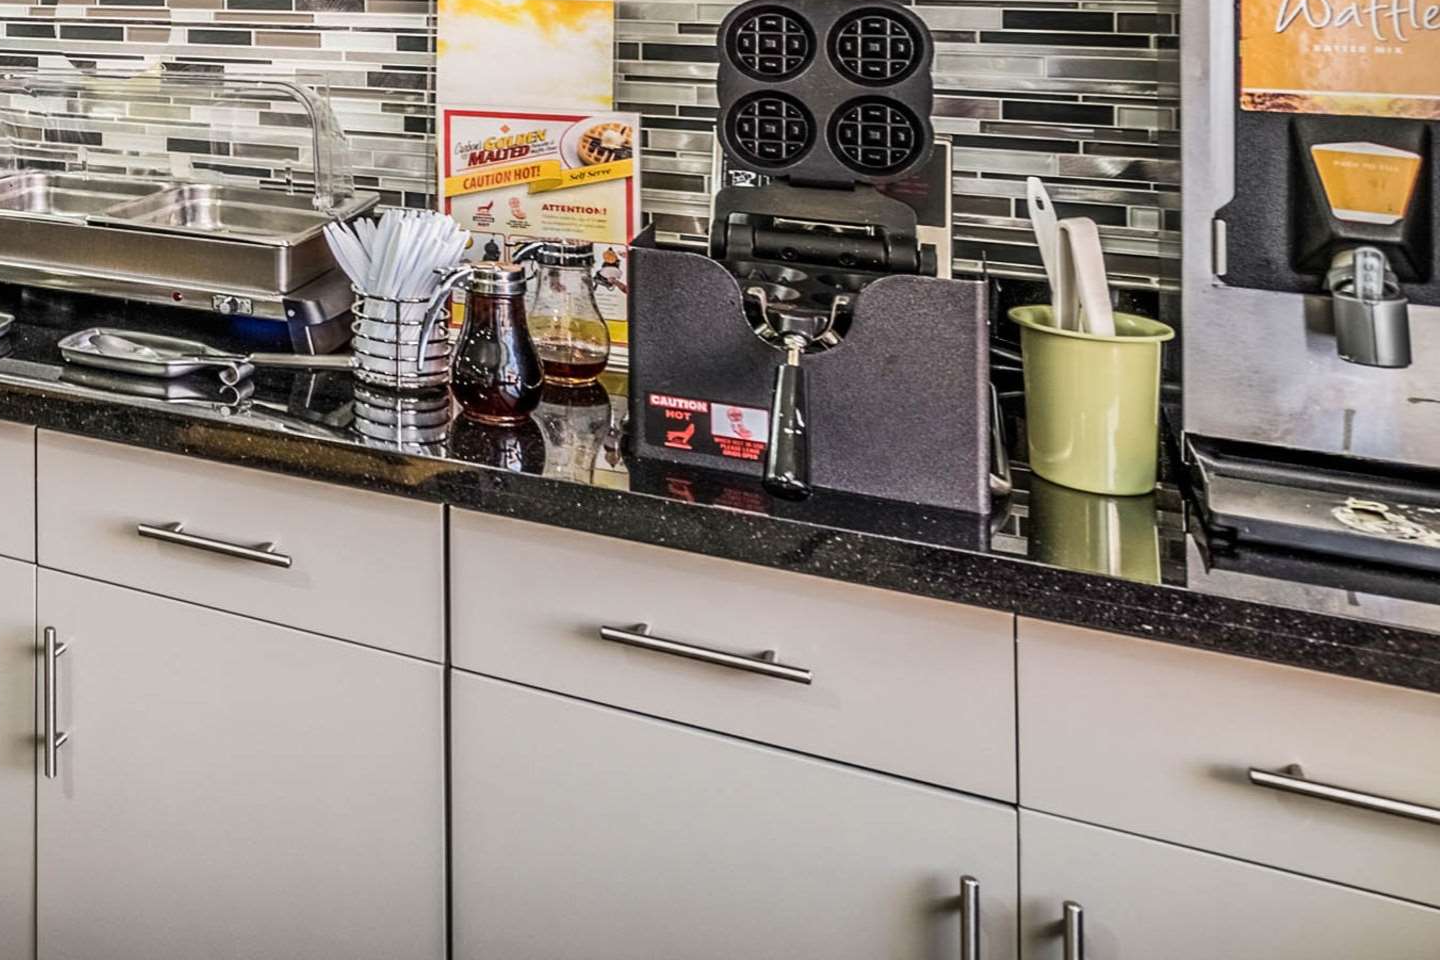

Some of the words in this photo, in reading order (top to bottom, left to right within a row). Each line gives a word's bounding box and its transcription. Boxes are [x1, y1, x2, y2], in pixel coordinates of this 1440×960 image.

[483, 127, 547, 151] GOLDEN
[467, 144, 530, 167] MALTED
[463, 170, 512, 190] CAUTION
[513, 165, 541, 182] HOT!
[541, 203, 607, 216] ATTENTION!
[649, 393, 709, 413] CAUTION
[665, 409, 692, 420] HOT
